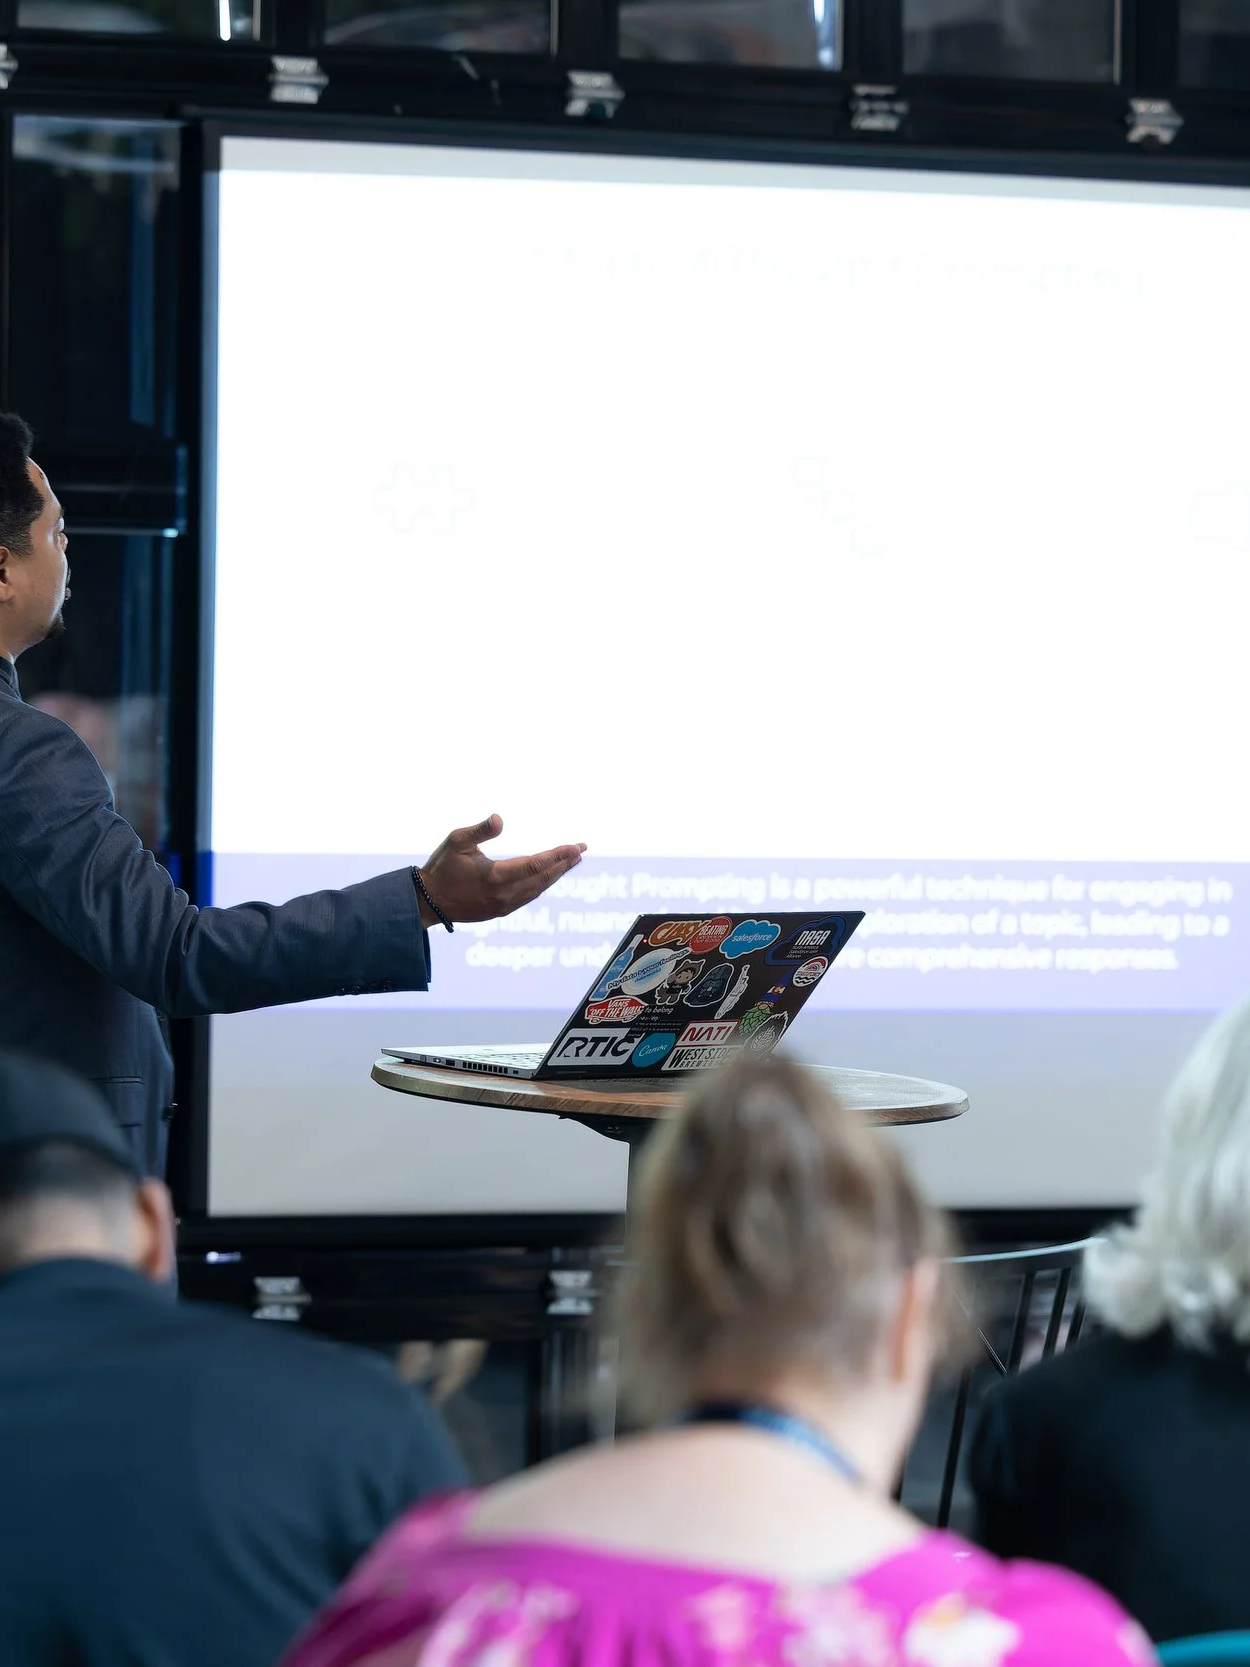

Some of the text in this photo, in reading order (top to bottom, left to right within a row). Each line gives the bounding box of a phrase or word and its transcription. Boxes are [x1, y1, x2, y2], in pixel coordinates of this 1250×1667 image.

[731, 932, 773, 943] salesforce
[794, 930, 831, 946] NASA
[608, 999, 631, 1009] VANS
[605, 1008, 622, 1018] THE
[681, 1026, 733, 1041] NATI
[556, 1036, 634, 1057] RTIC
[638, 1044, 668, 1057] Canva
[669, 1048, 707, 1068] WEST
